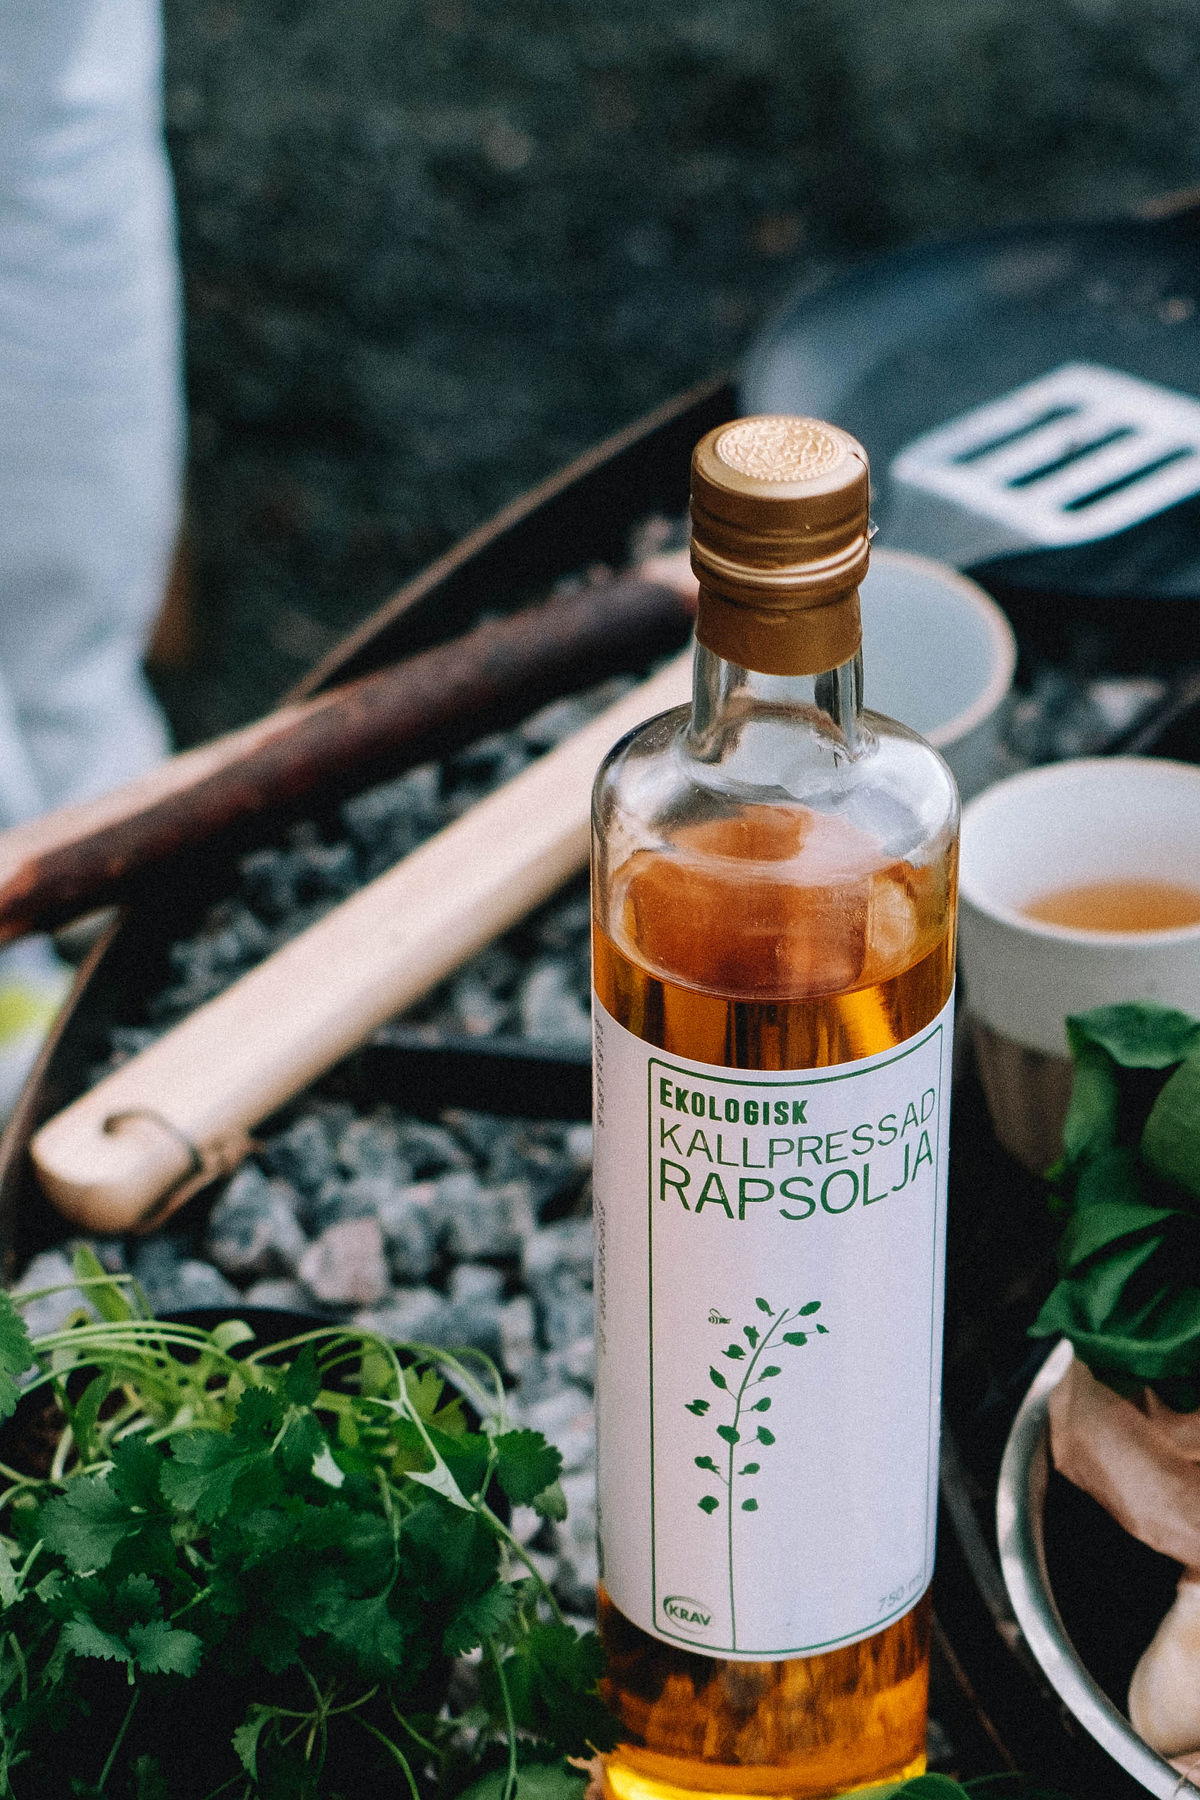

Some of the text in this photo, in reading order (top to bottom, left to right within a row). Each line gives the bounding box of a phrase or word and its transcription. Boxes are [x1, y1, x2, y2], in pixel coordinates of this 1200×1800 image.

[659, 1077, 808, 1126] EKOLOGISK
[659, 1087, 936, 1169] KALLPRESSAD
[659, 1129, 933, 1221] RAPSOLJA
[669, 1603, 711, 1626] KRAV
